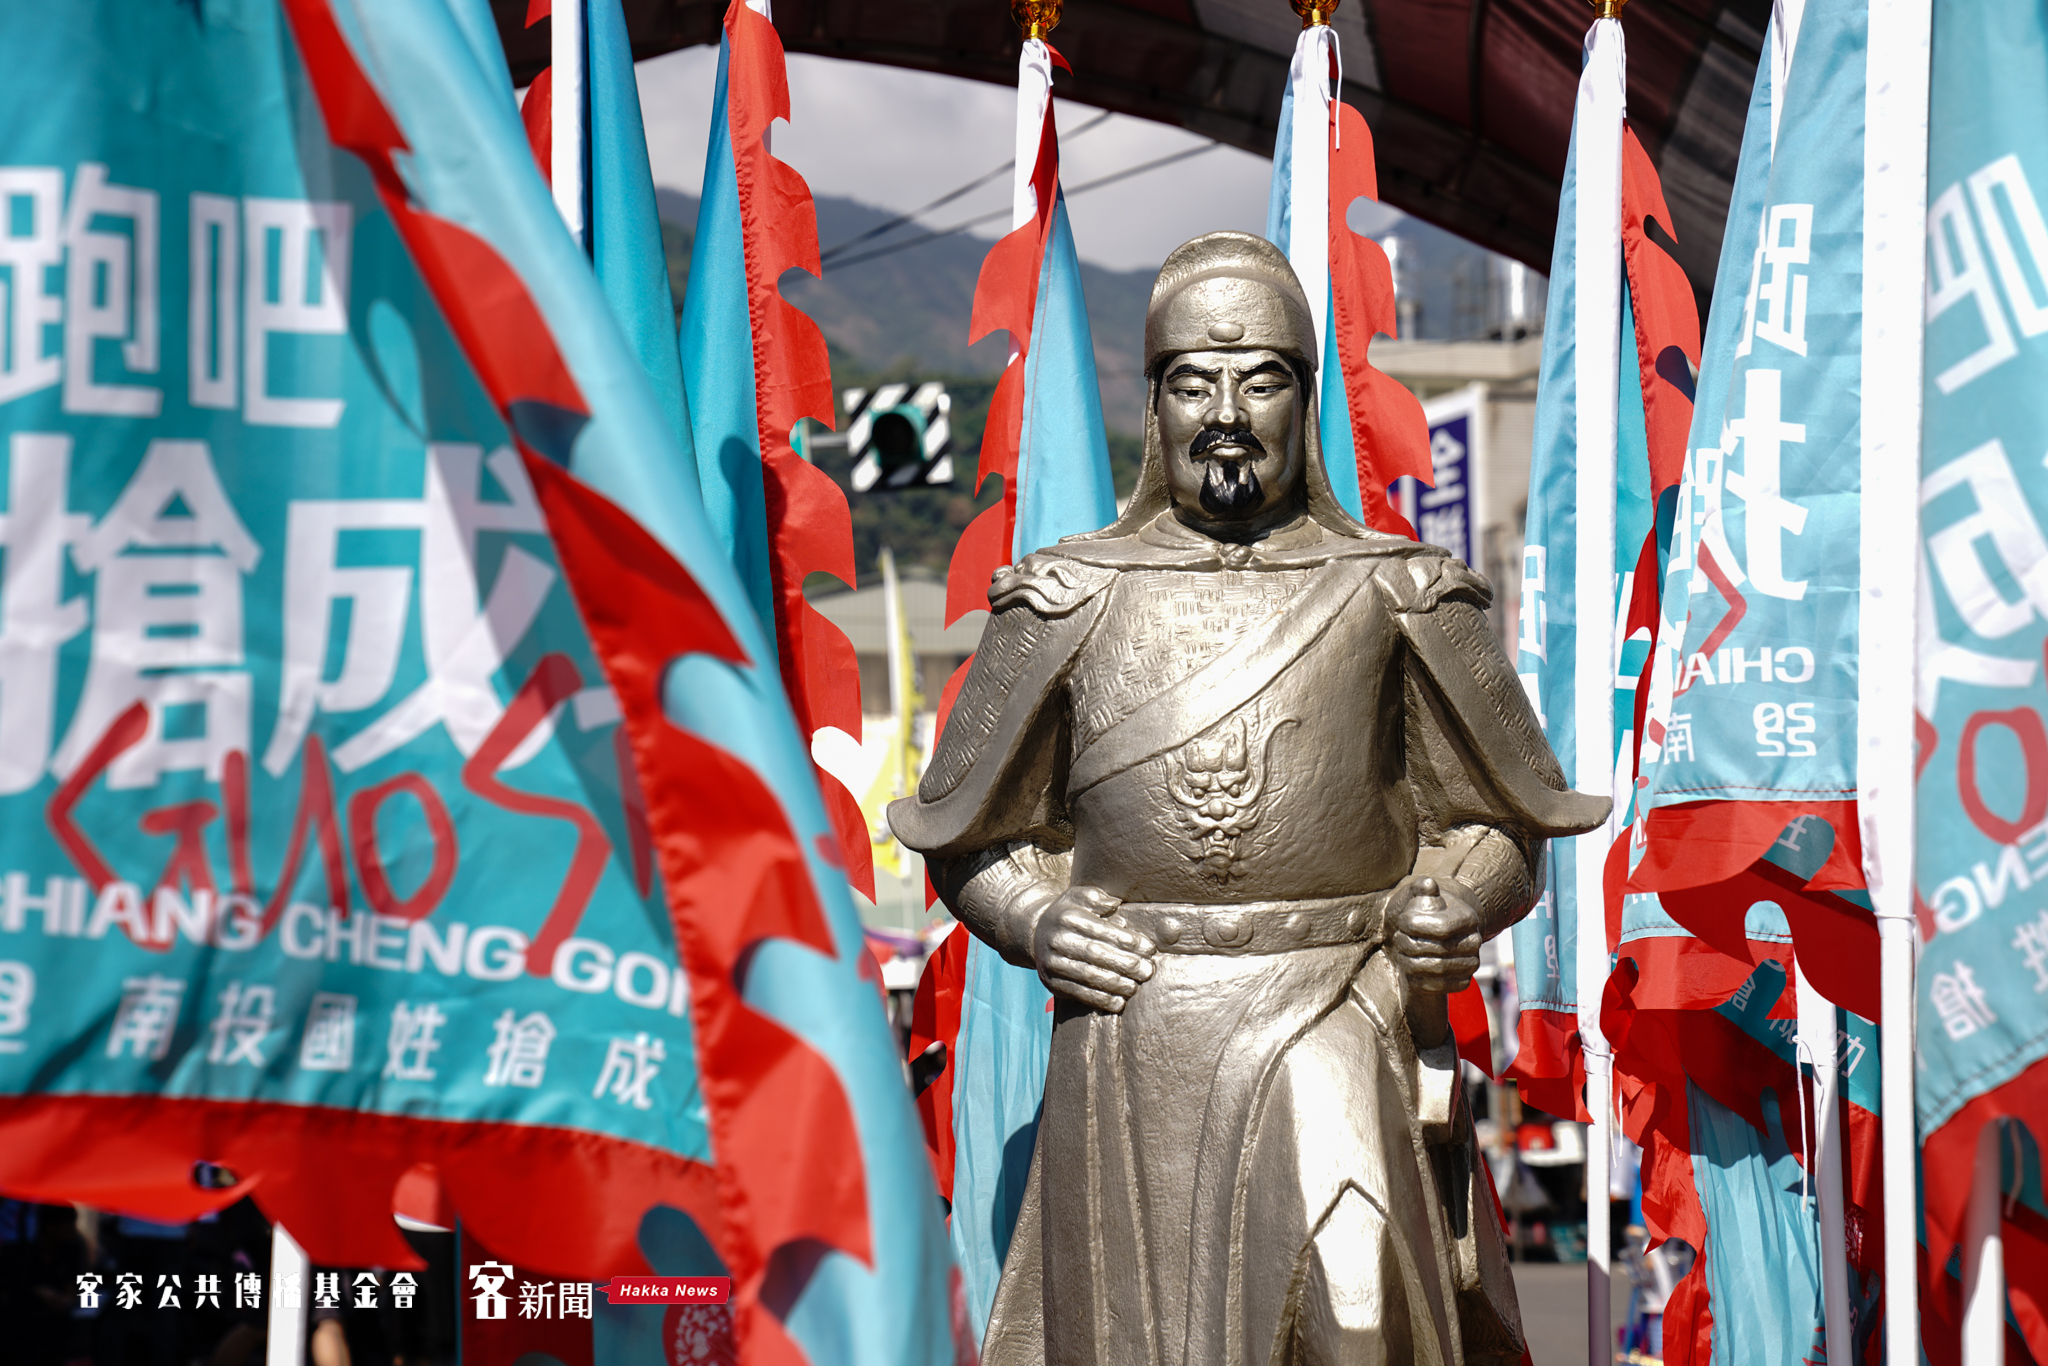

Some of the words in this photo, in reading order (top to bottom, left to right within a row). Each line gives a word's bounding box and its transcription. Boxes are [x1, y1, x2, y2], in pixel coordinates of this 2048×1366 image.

[278, 902, 527, 982] CHENG
[105, 972, 667, 1110] 南投國姓搶成
